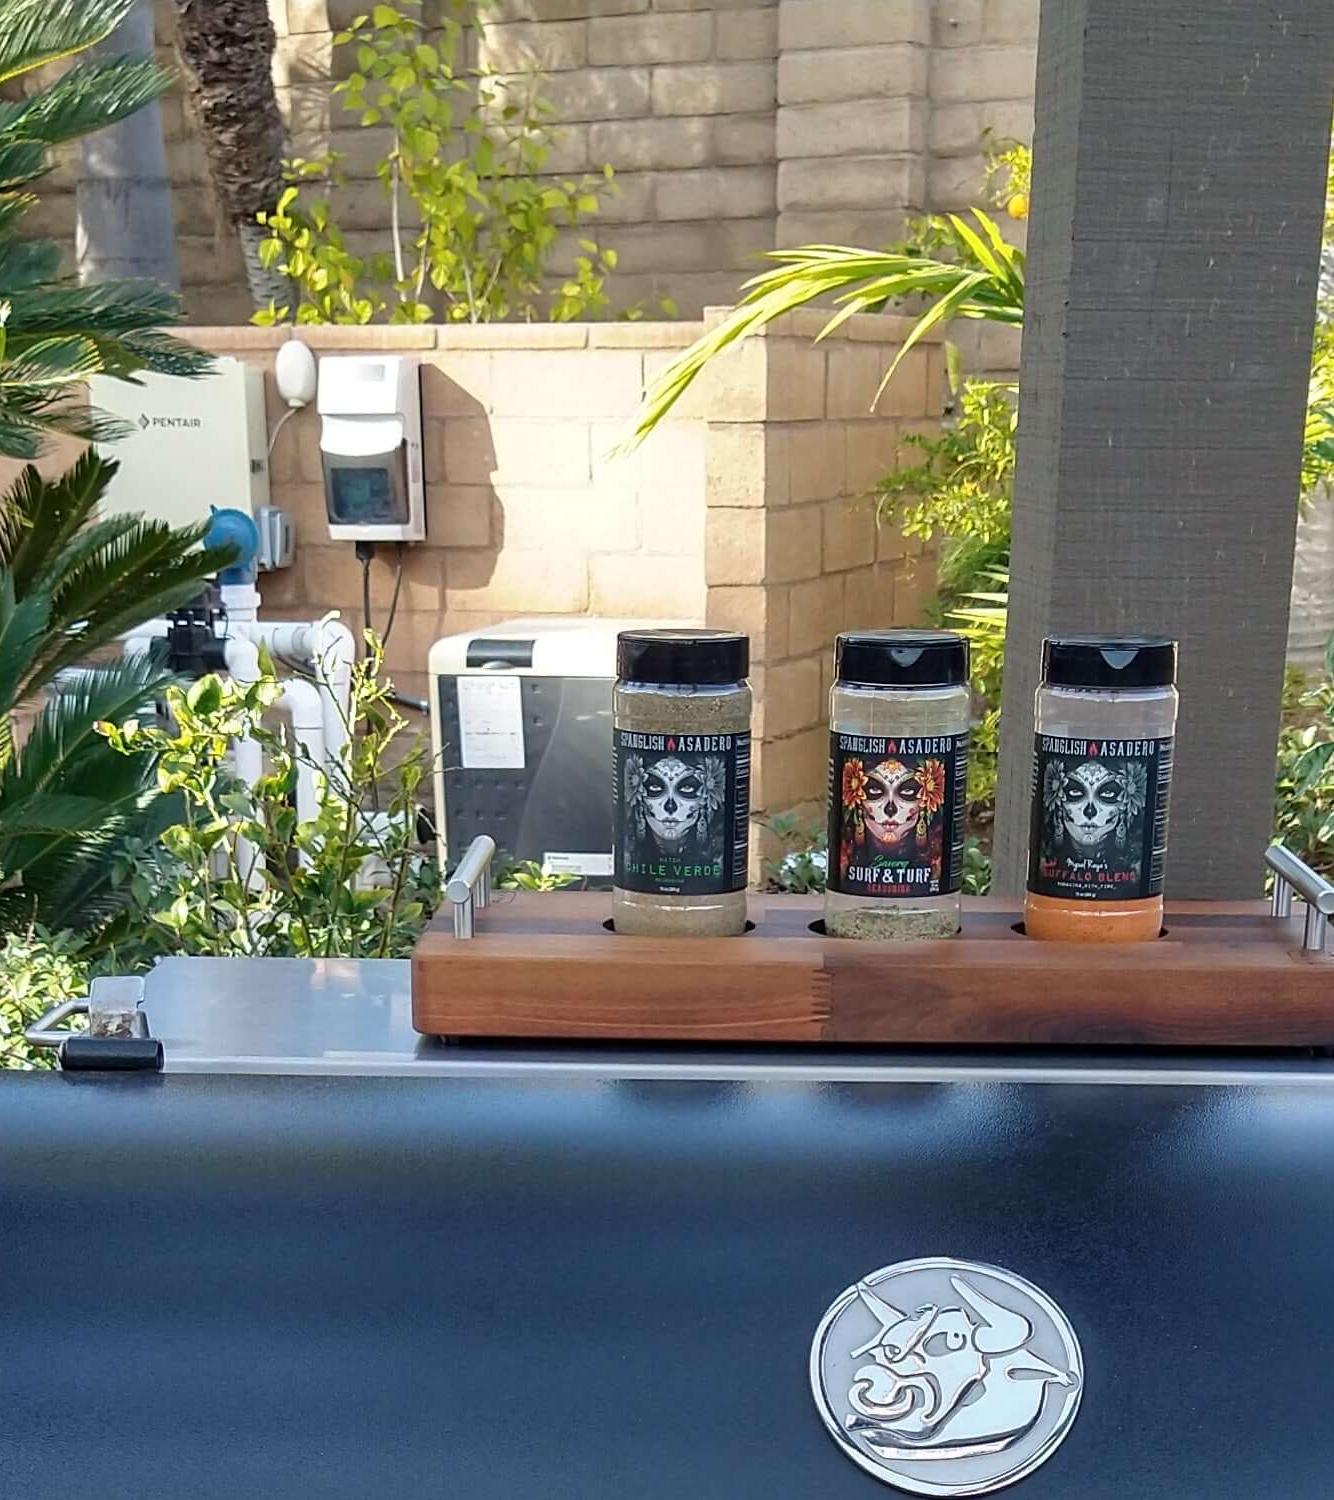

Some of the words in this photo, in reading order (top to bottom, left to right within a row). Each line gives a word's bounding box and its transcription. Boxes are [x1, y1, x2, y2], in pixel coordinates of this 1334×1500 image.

[152, 417, 201, 428] PENTAIR
[620, 731, 665, 751] SPANGLISH
[678, 735, 732, 752] ASADERO
[839, 735, 886, 754] SPANGLISH
[899, 737, 952, 755] ASADERO
[1042, 737, 1087, 756] SPANGLISH
[1100, 740, 1155, 757] ASADERO
[673, 864, 722, 877] VERDE
[848, 866, 881, 883] SURF
[882, 869, 894, 884] &
[897, 867, 931, 883] TURF
[1098, 870, 1136, 882] BLEND
